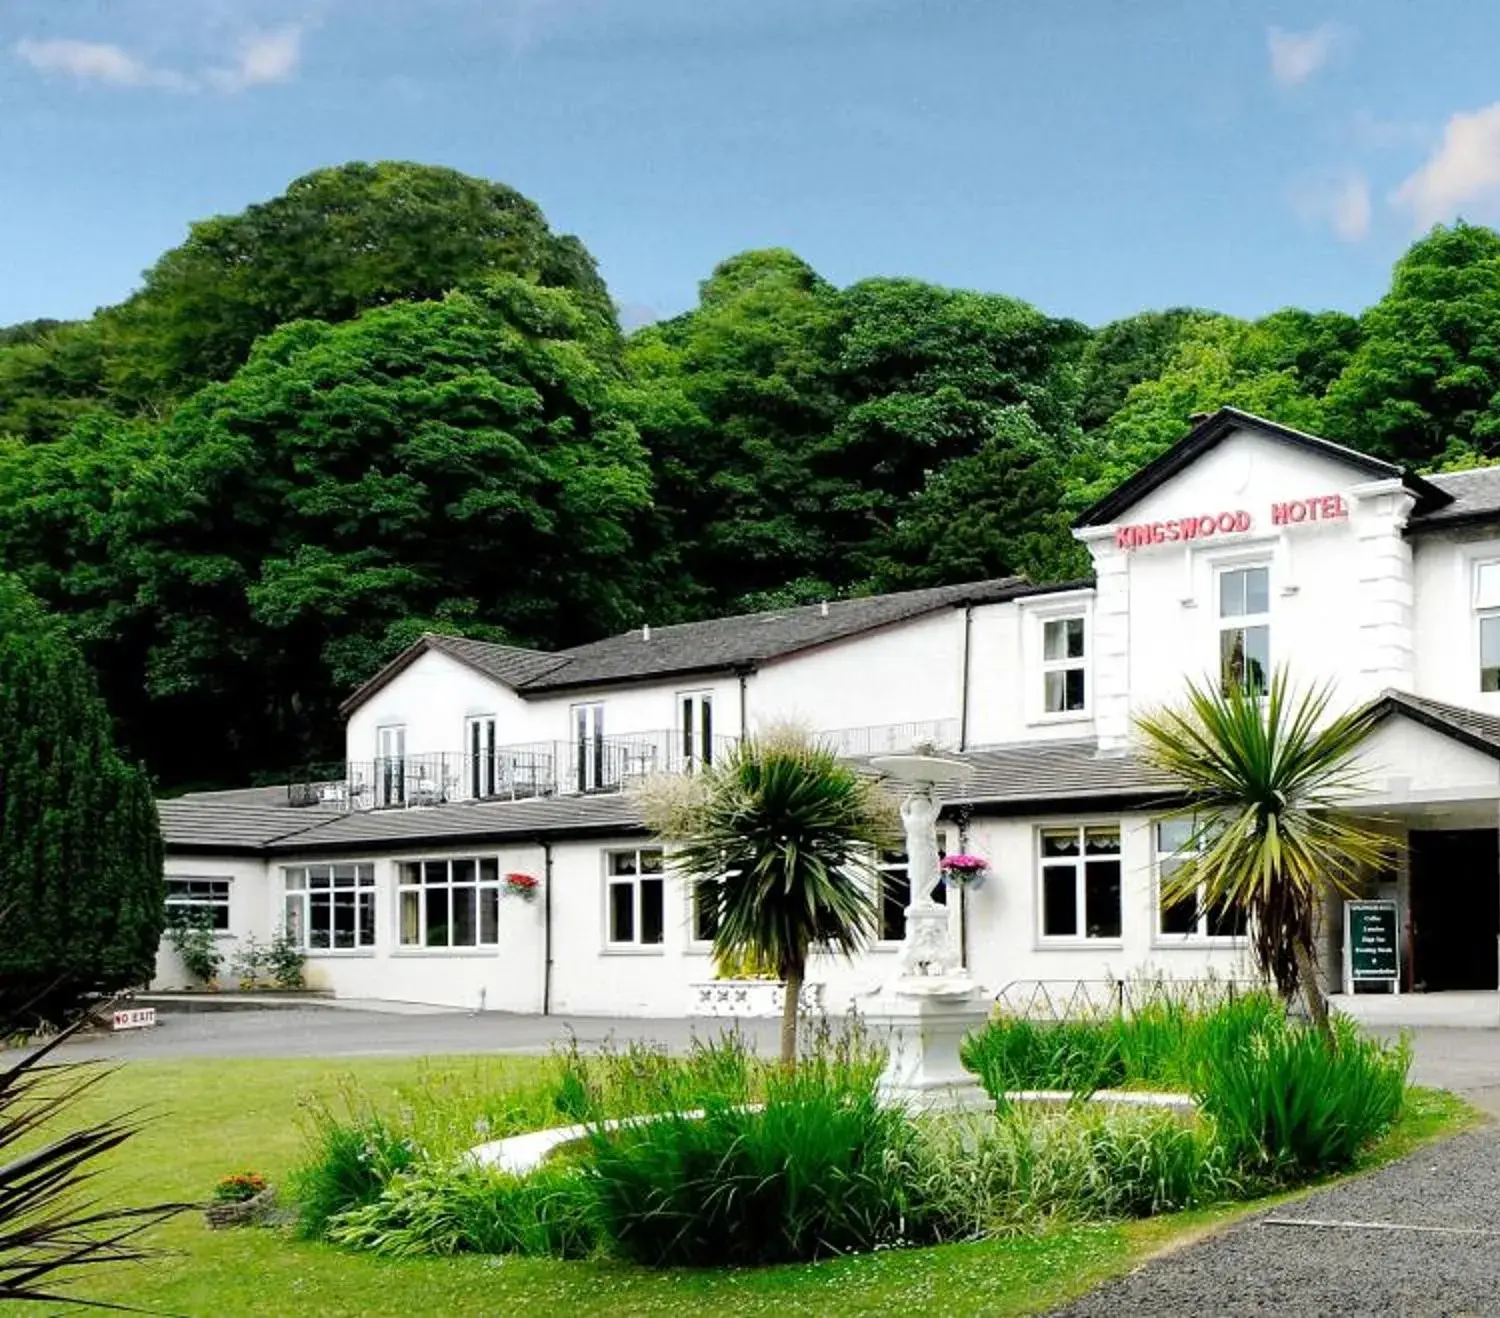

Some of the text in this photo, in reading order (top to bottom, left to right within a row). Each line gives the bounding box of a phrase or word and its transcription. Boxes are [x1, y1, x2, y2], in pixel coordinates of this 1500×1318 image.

[1115, 494, 1348, 548] KINGSWOOD HOTEL
[115, 1011, 153, 1024] NO EXIT
